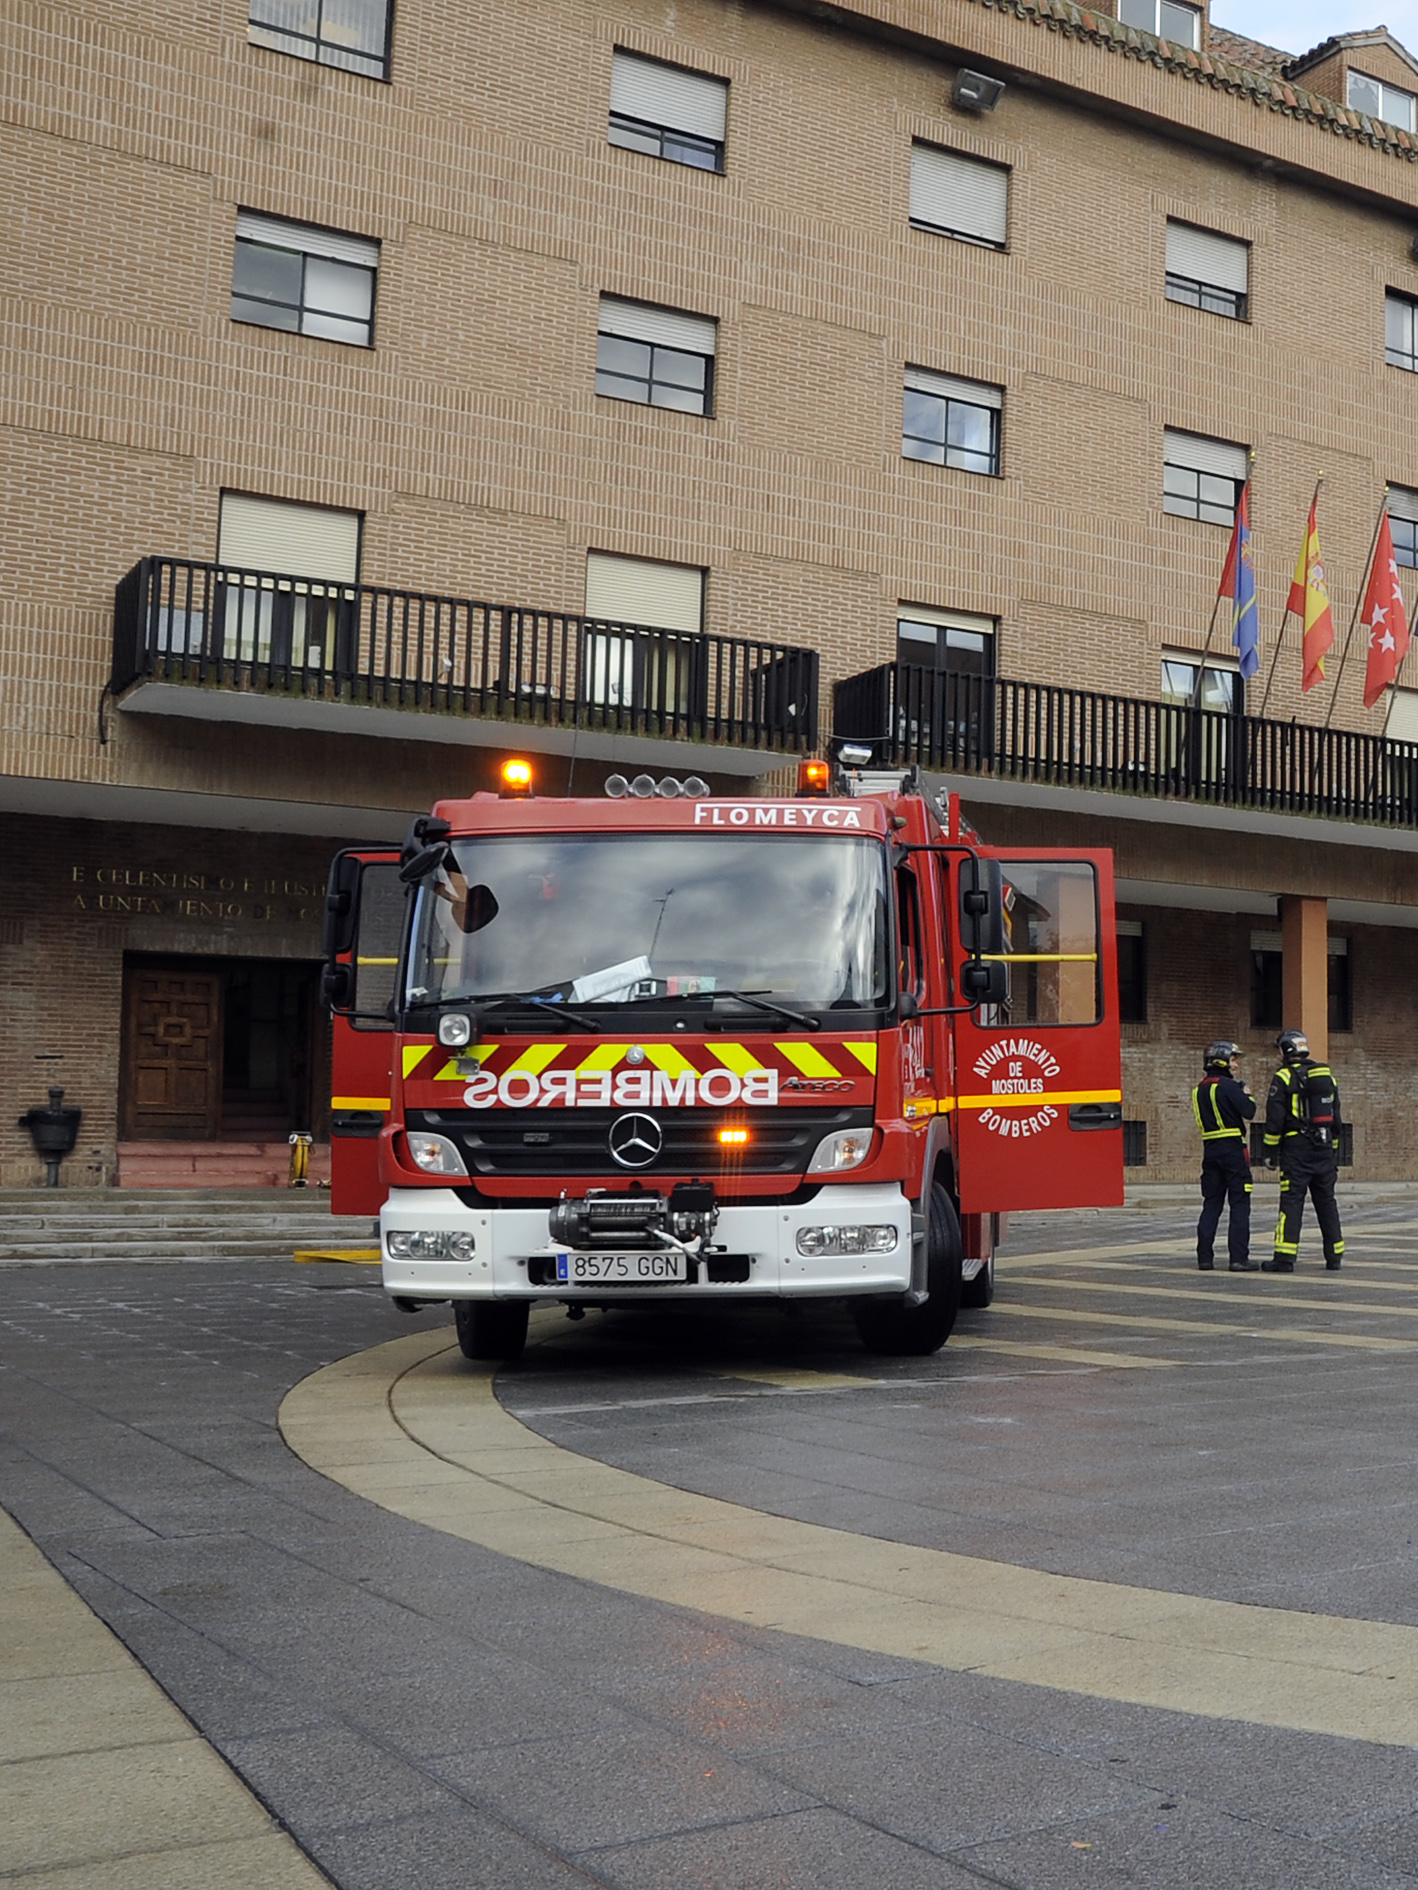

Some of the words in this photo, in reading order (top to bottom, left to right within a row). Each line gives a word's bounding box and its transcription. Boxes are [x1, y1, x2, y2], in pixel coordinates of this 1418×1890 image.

[694, 803, 861, 828] FLOMEYCA
[972, 1038, 1060, 1079] AYUNTAMIENTO
[1009, 1061, 1023, 1077] DE
[992, 1078, 1044, 1094] MOSTOLES
[978, 1105, 1059, 1138] BOMBEROS
[575, 1256, 629, 1277] 8575
[637, 1256, 678, 1277] GGN
